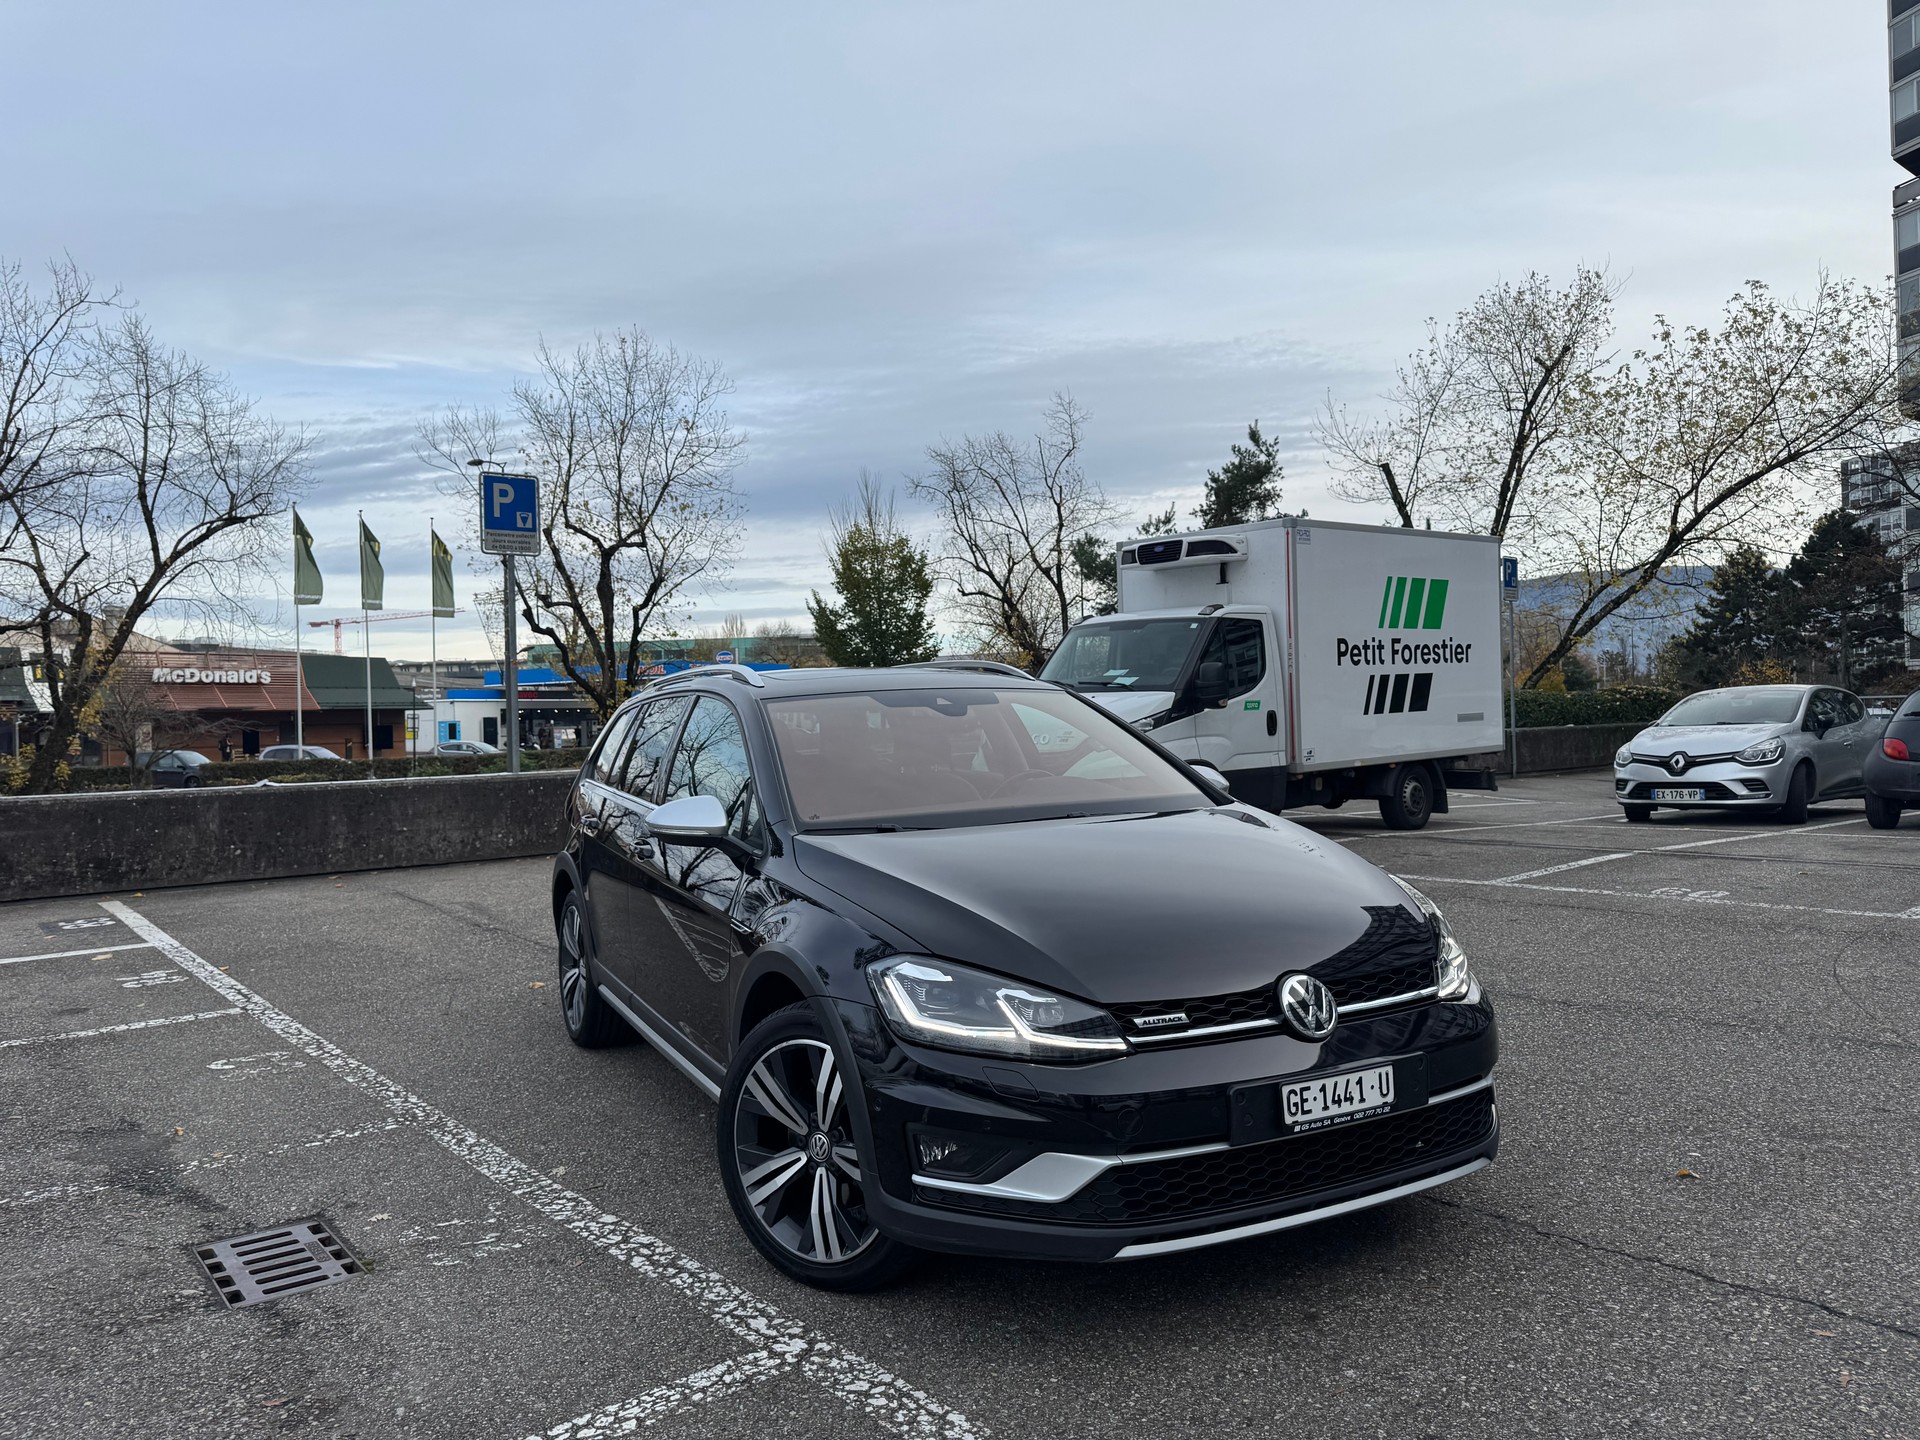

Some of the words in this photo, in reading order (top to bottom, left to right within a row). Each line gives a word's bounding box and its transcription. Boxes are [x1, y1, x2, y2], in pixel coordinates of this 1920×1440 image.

[493, 482, 515, 518] P
[1505, 561, 1512, 582] P
[1337, 637, 1385, 666] Petit
[1391, 636, 1472, 665] Forestier
[152, 667, 271, 684] McDonald's
[1142, 1015, 1184, 1026] ALLTRACK
[1310, 1121, 1322, 1129] Auto
[1323, 1118, 1331, 1126] SA
[1365, 1109, 1375, 1117] 777
